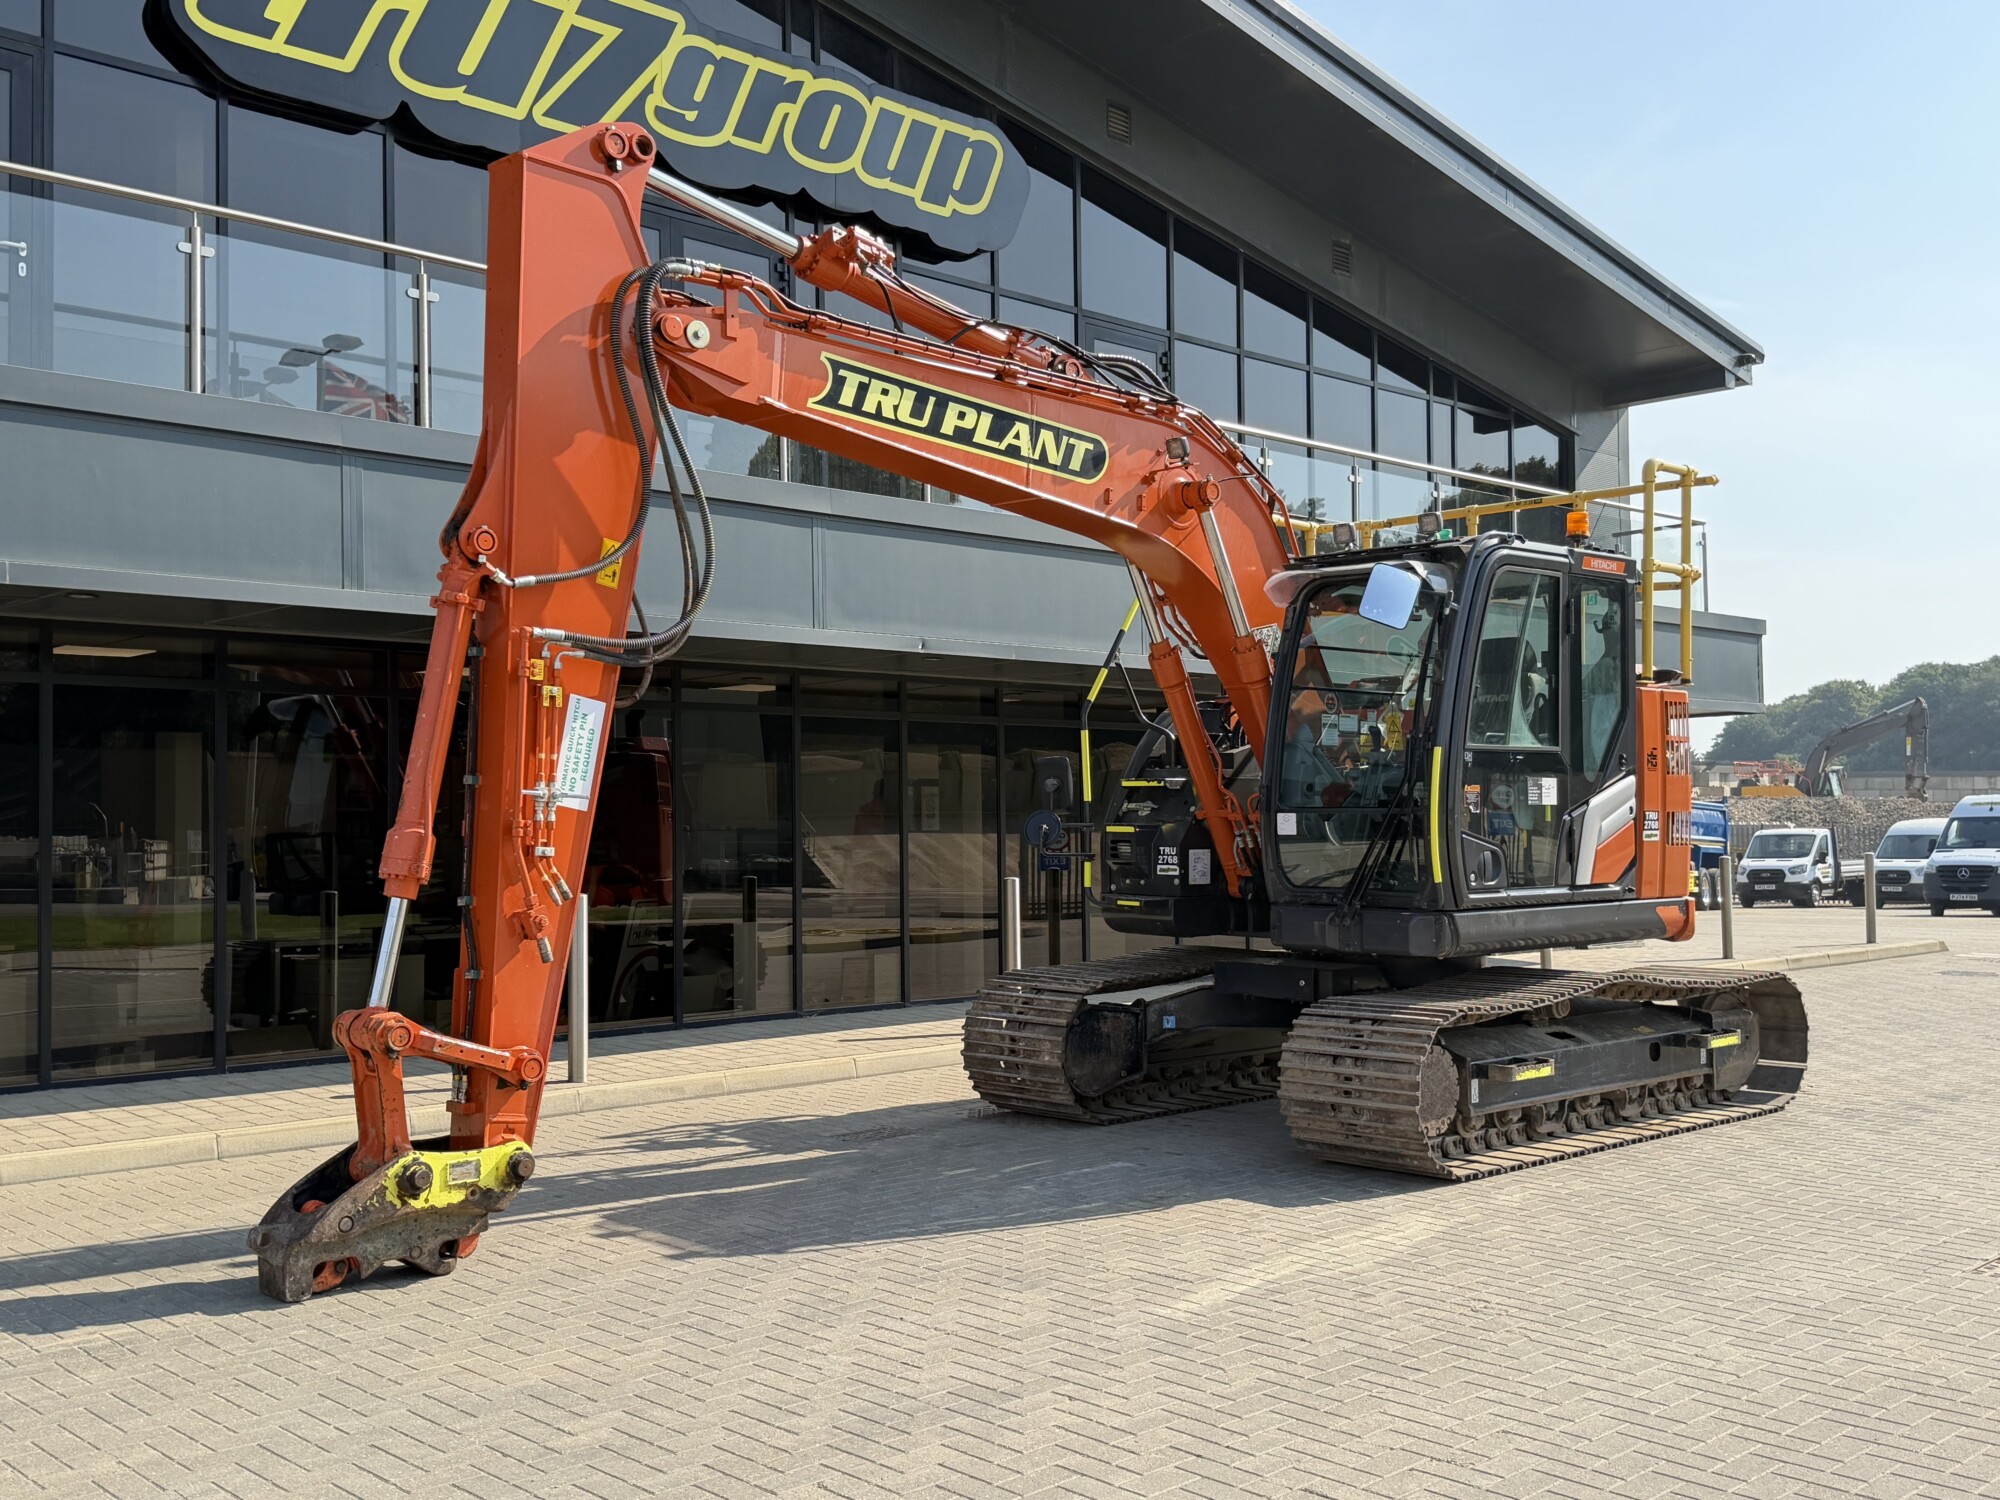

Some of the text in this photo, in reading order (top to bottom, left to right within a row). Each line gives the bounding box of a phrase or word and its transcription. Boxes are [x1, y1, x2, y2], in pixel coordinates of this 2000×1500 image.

[837, 368, 1095, 472] TRU PLANT
[1590, 558, 1617, 571] HITACHI
[567, 725, 577, 753] QUICK
[572, 698, 582, 724] HITCH
[569, 712, 589, 792] NO SAFETY PIN
[580, 728, 595, 782] REQUIRED
[1644, 811, 1658, 820] TRU
[1643, 820, 1659, 830] 2768
[1159, 846, 1177, 855] TRU
[1157, 855, 1178, 864] 2768
